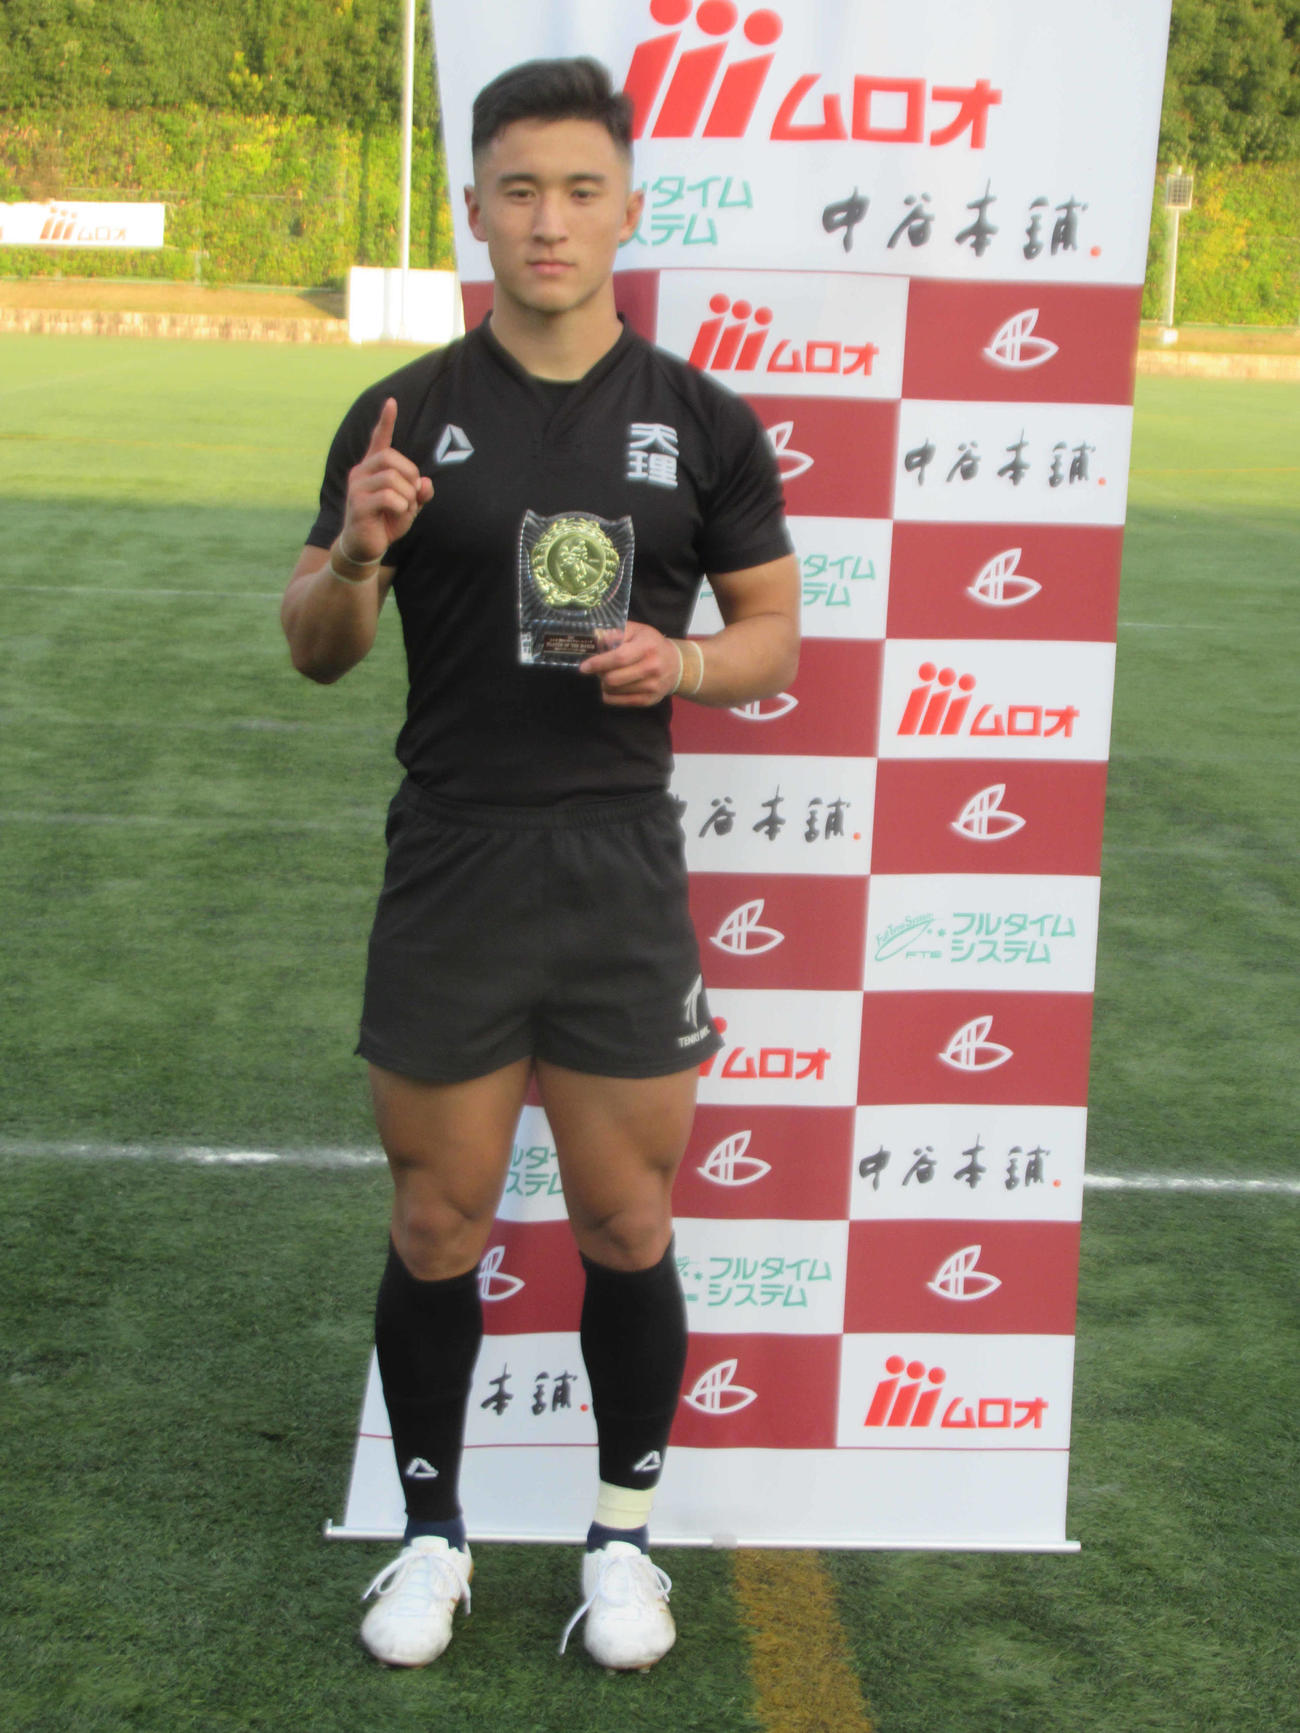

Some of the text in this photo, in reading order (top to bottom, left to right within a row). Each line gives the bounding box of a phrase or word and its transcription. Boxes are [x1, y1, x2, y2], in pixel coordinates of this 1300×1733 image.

[769, 73, 1002, 149] ムロオ
[642, 175, 753, 209] タイム
[767, 340, 879, 376] ムロオ
[796, 554, 876, 580] タイム
[969, 704, 1080, 738] ムロオ
[951, 912, 1076, 939] フルタイム
[950, 939, 1052, 964] システム
[721, 1047, 831, 1081] ムロオ
[709, 1257, 833, 1282] フルタイム
[707, 1283, 808, 1308] システム
[941, 1397, 1048, 1429] ムロオ
